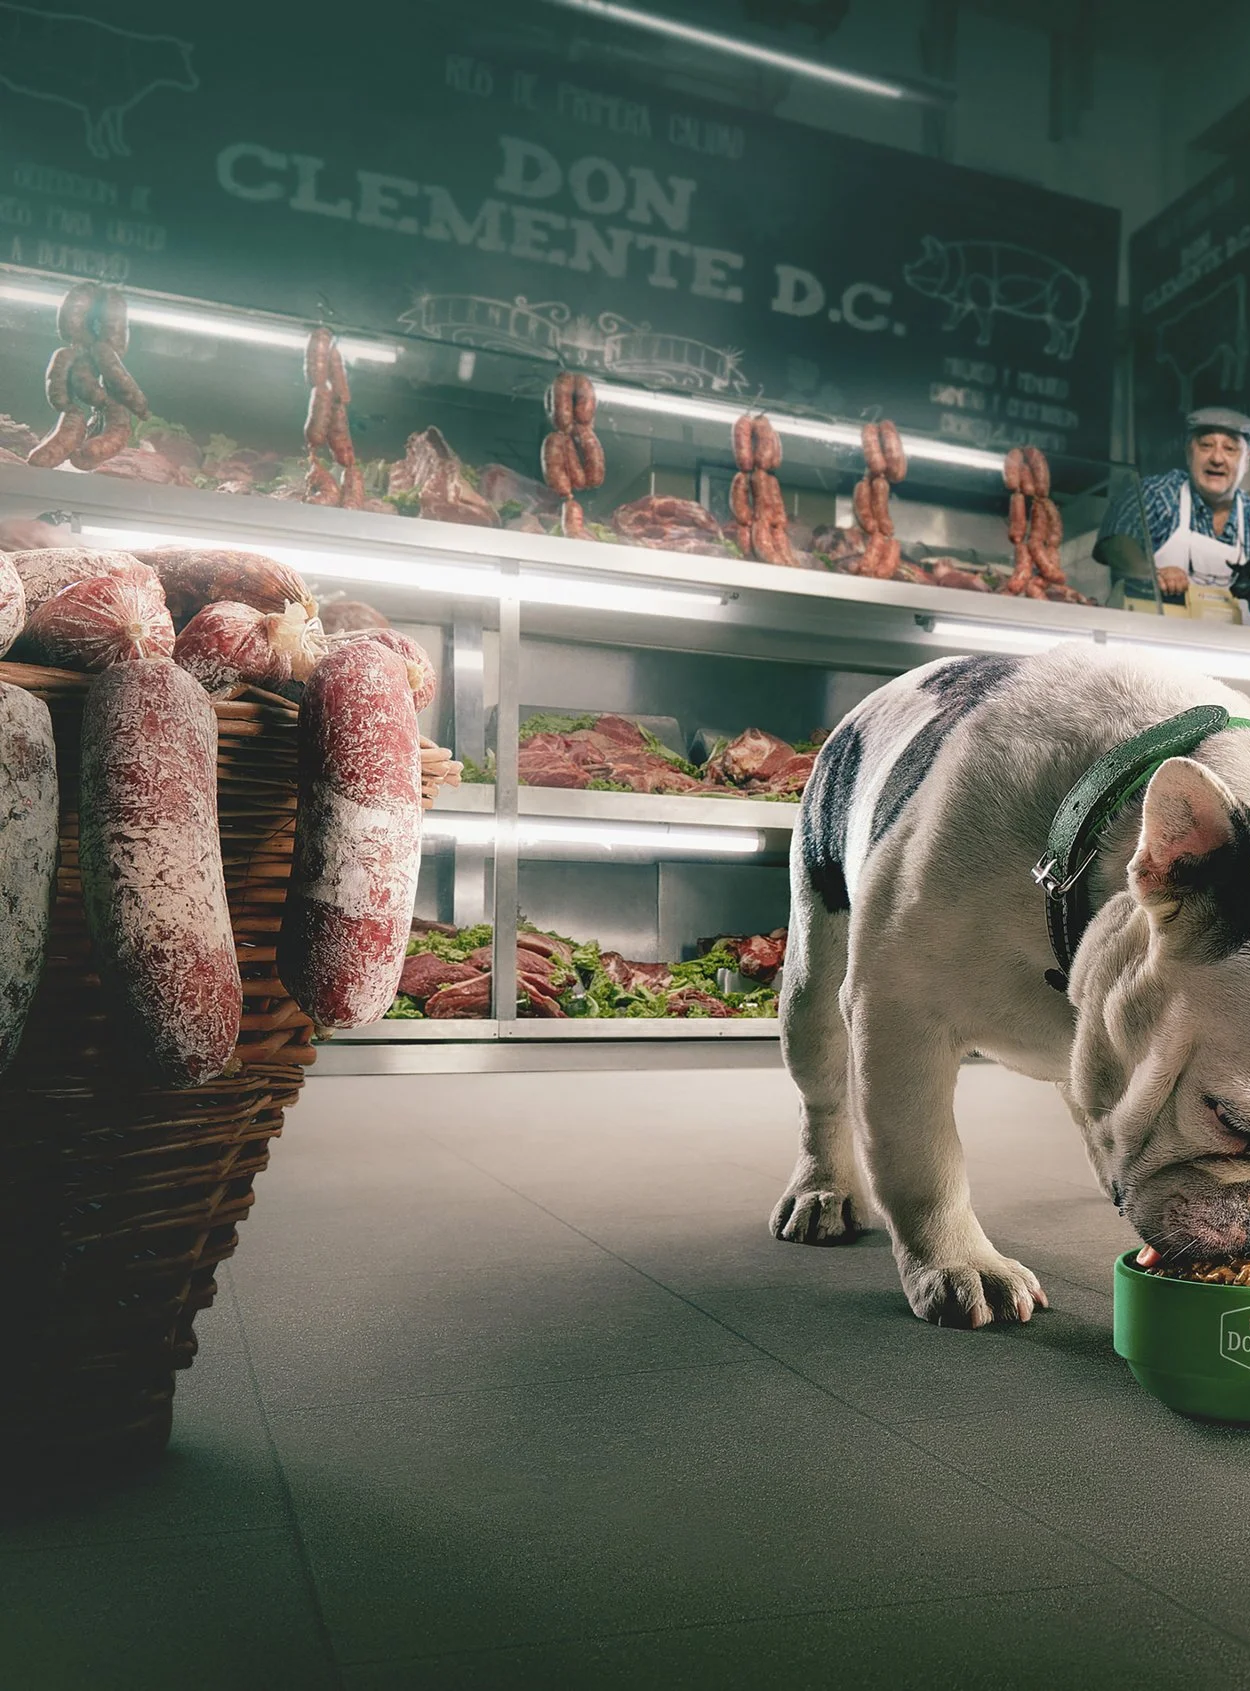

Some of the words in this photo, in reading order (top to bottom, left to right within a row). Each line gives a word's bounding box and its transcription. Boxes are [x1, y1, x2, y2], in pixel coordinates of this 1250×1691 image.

[215, 140, 745, 304] CLEMENTE
[771, 261, 906, 337] D.C.
[495, 133, 698, 233] DON
